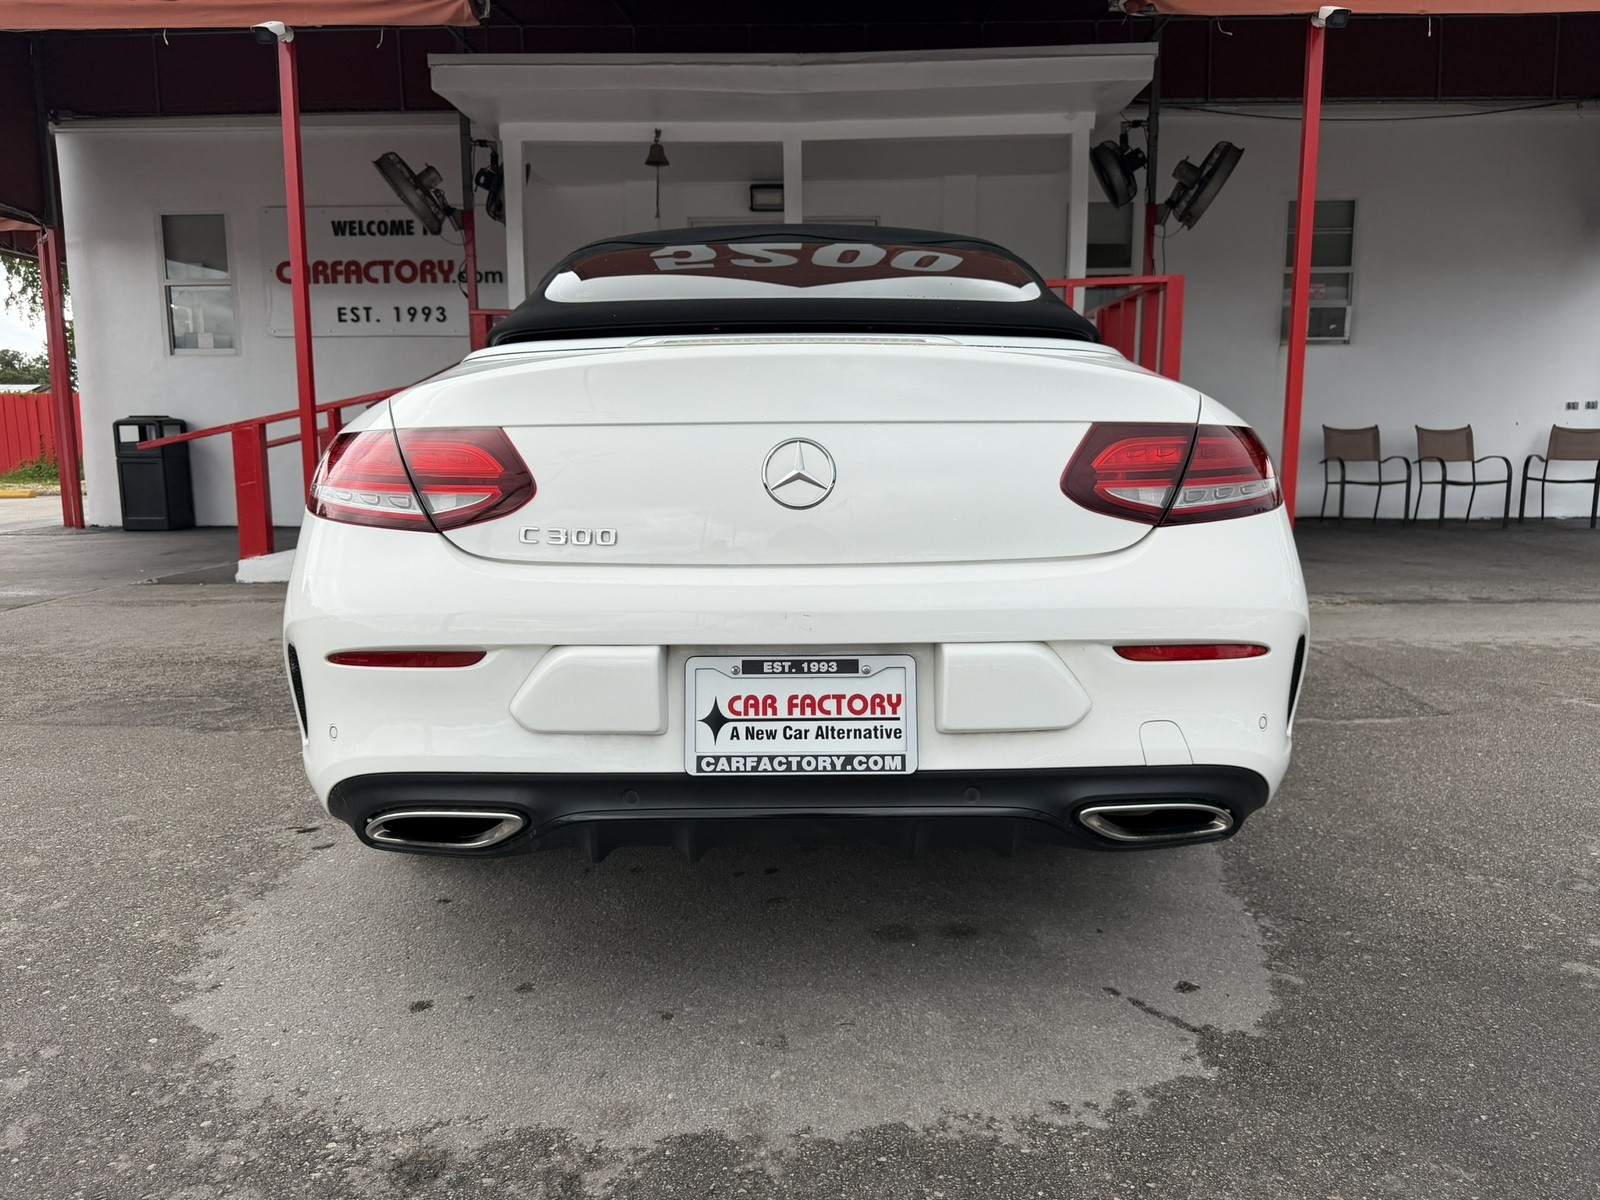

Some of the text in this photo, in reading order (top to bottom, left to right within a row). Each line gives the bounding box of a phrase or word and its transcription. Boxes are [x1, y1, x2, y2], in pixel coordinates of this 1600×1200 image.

[331, 220, 415, 236] WELCOME
[276, 259, 503, 284] CRFACTORY.com
[337, 306, 447, 323] EST. 1993
[519, 526, 618, 546] C 300
[763, 661, 838, 673] EST. 1993
[728, 693, 902, 717] CAR FACTORY
[729, 724, 903, 741] A New Car Alternative
[701, 755, 902, 772] CARFACTORY.COM
